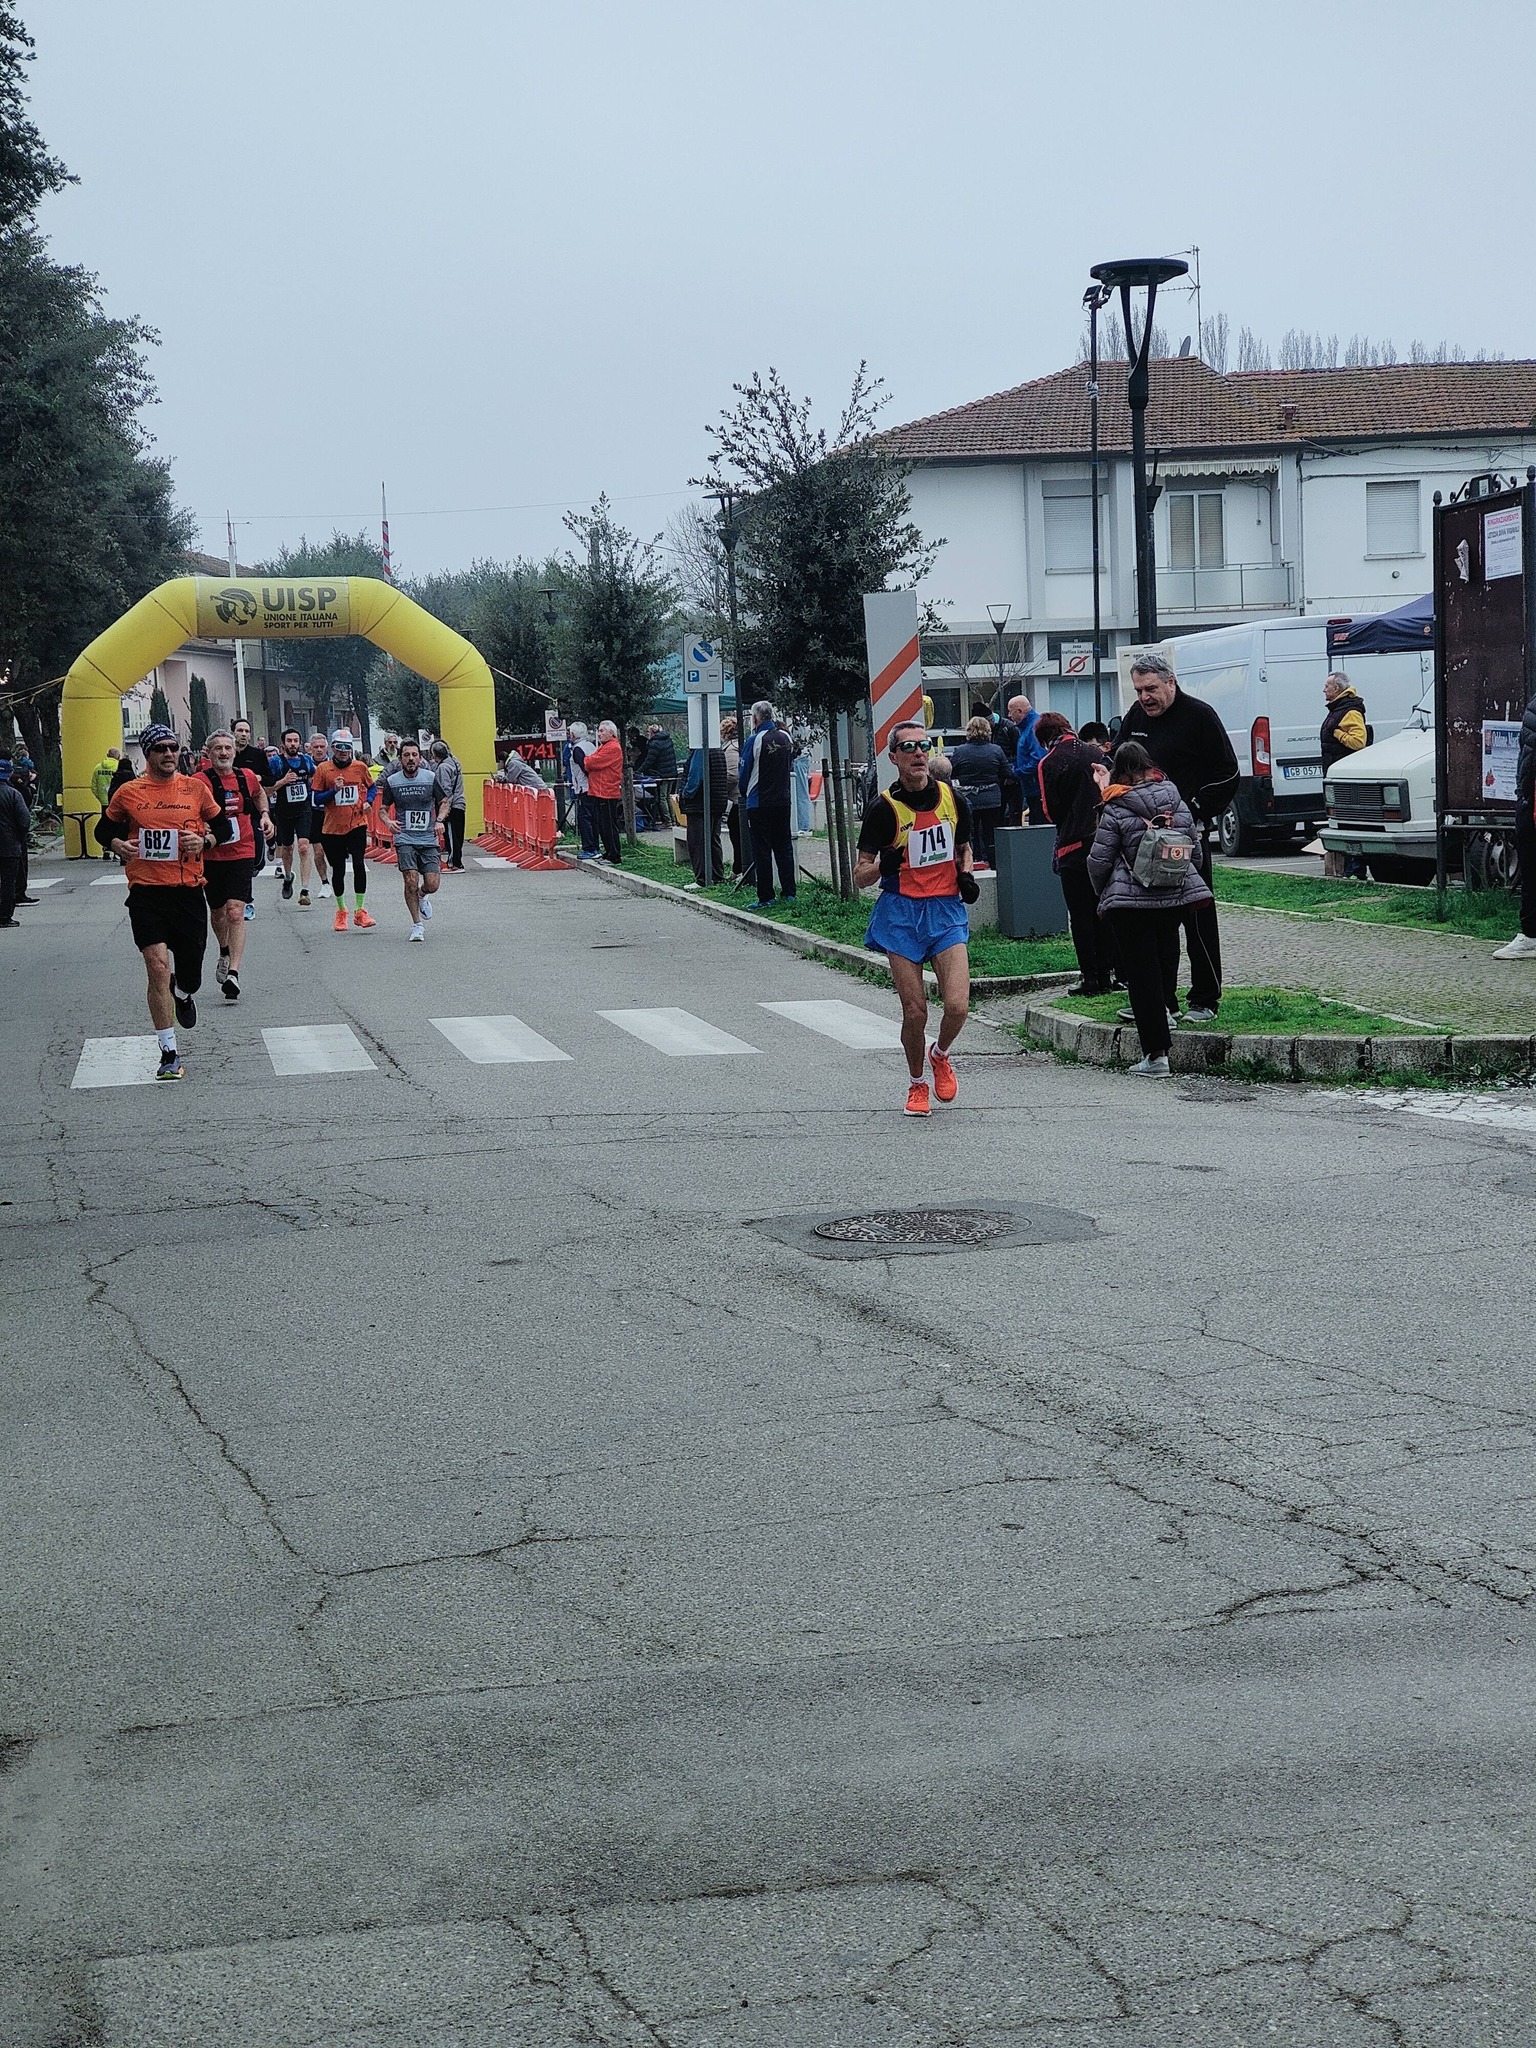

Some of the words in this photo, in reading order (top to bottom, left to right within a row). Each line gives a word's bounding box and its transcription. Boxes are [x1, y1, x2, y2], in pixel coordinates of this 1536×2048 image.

[262, 587, 337, 611] UISP
[264, 613, 297, 621] UNIONE
[300, 612, 338, 621] ITALIANA
[290, 785, 304, 797] 630
[154, 801, 191, 810] Lamone
[410, 812, 426, 824] 624
[144, 830, 171, 850] 682
[919, 826, 946, 853] 714
